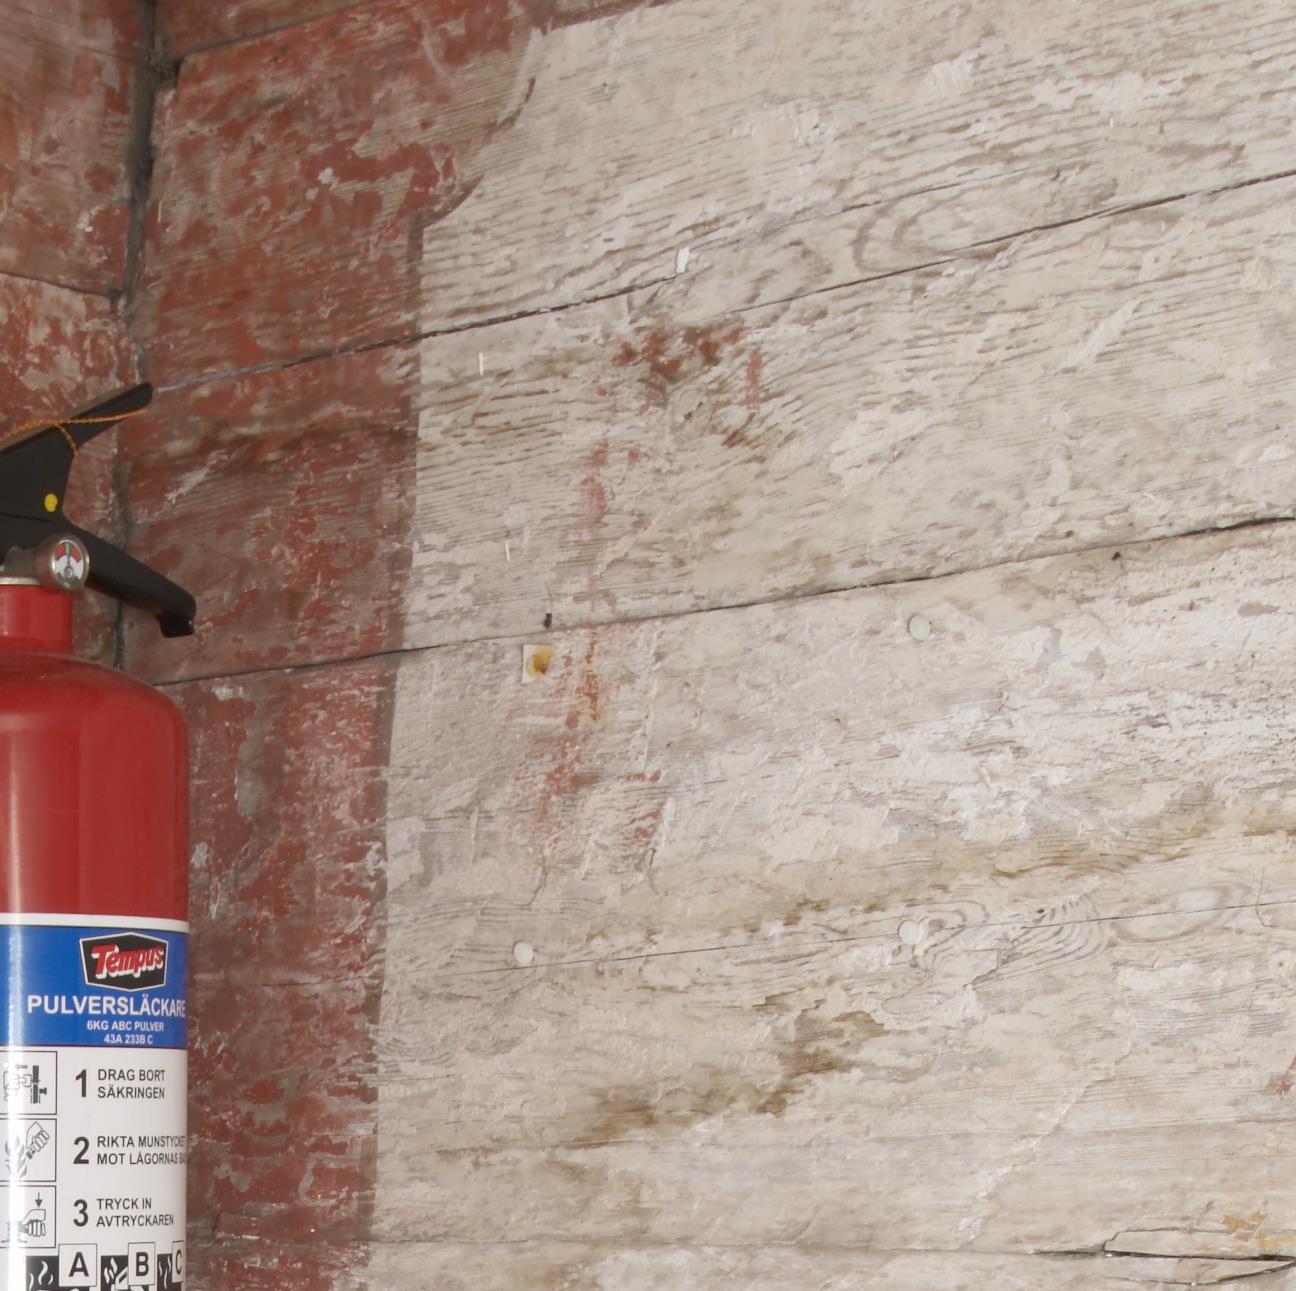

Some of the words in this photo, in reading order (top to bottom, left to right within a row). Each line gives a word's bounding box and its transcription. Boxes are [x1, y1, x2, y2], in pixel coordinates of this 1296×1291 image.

[90, 942, 164, 980] Tempus
[27, 994, 186, 1018] PULVERSLÄCKARE
[112, 1021, 132, 1031] ABC
[134, 1022, 164, 1032] PULVER
[75, 1069, 87, 1098] 1
[98, 1069, 135, 1081] DRAG
[139, 1069, 165, 1082] BORT
[97, 1084, 165, 1099] SÄKRINGEN
[73, 1136, 90, 1165] 2
[97, 1136, 134, 1148] RIKTA
[97, 1153, 125, 1165] MOT
[73, 1199, 88, 1227] 3
[96, 1198, 139, 1210] TRYCK
[142, 1198, 152, 1210] IN
[96, 1214, 174, 1228] AVTRYCKAREN
[68, 1251, 89, 1277] A
[135, 1252, 149, 1276] B
[175, 1250, 182, 1275] C
